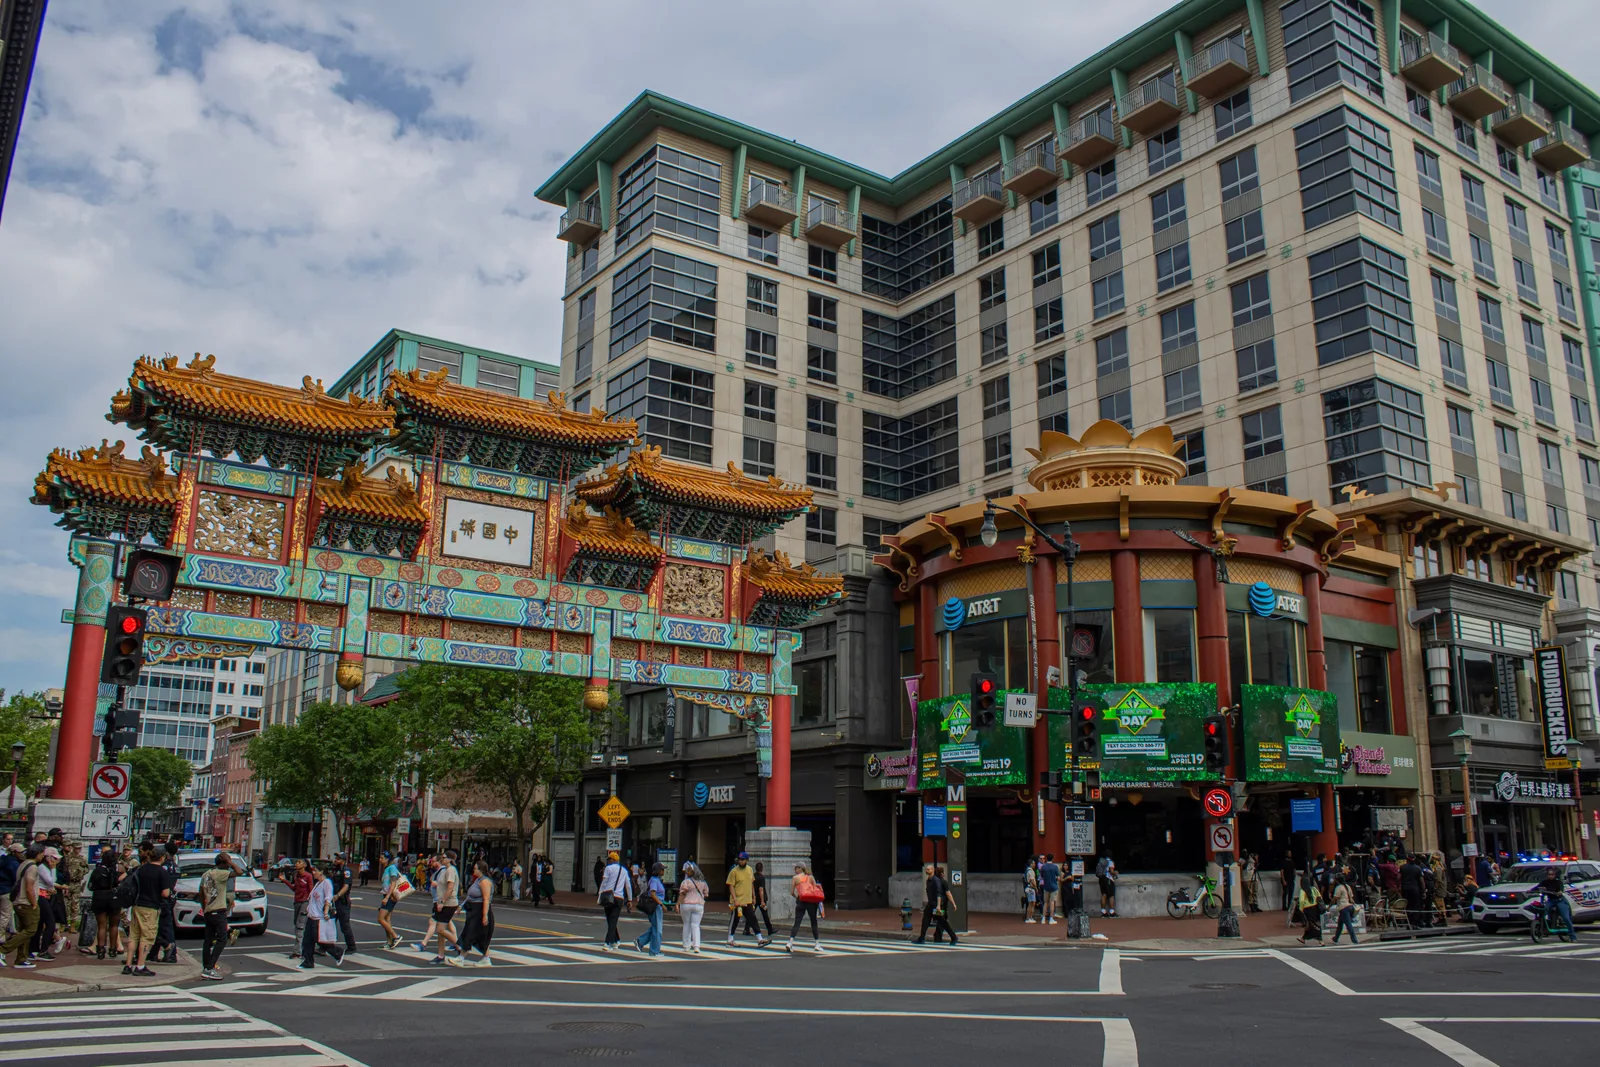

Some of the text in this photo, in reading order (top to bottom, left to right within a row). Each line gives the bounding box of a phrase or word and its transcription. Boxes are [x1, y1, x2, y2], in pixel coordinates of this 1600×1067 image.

[968, 597, 1001, 618] AT&T
[1278, 595, 1300, 613] AT&T
[1016, 697, 1027, 706] NO
[1541, 651, 1567, 755] FUDDRUCKERS
[1009, 709, 1033, 719] TURNS
[1121, 716, 1147, 726] DAY
[1297, 719, 1312, 729] DAY
[950, 725, 967, 735] DAY
[1191, 753, 1204, 764] 19
[1353, 746, 1385, 762] planet
[999, 758, 1011, 768] 19
[1358, 760, 1391, 775] fitness
[708, 785, 735, 803] AT&T
[948, 785, 964, 801] M
[1092, 789, 1100, 798] 13
[1520, 781, 1571, 798] 世界上最好漢堡
[85, 820, 96, 829] CK
[609, 840, 619, 848] 25
